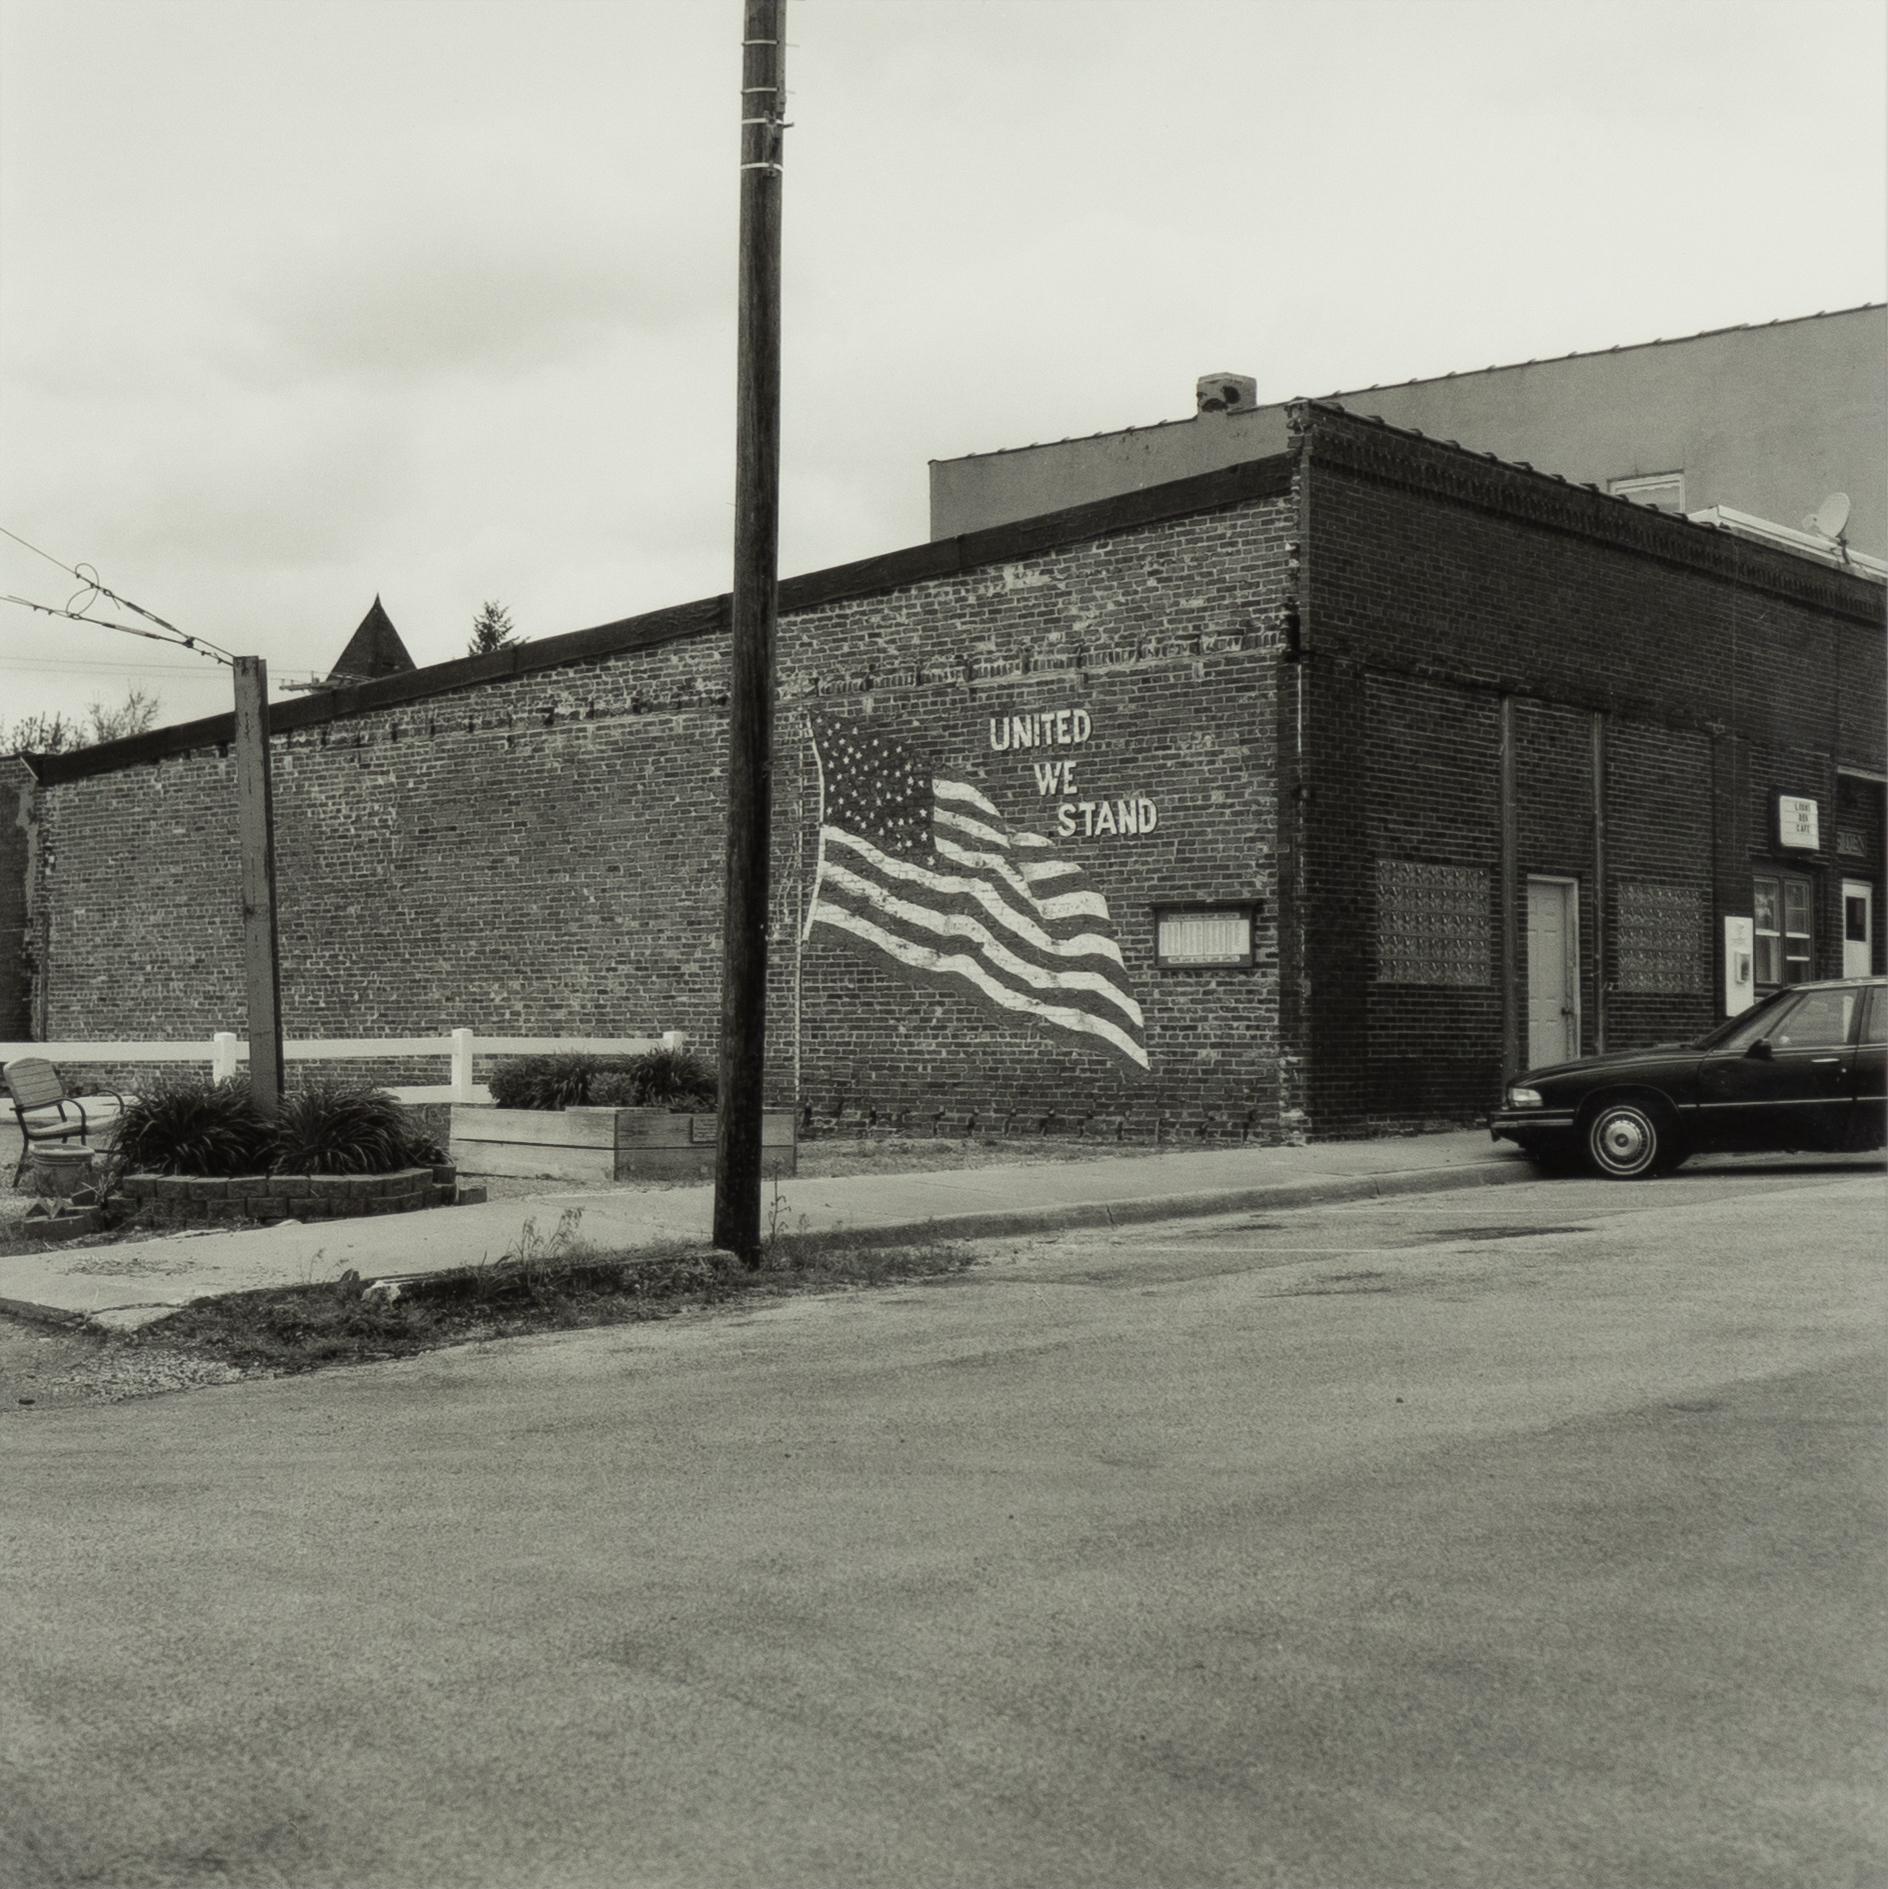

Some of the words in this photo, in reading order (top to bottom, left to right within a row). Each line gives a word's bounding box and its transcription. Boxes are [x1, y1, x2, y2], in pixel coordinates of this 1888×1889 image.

[990, 708, 1092, 751] UNITED
[1034, 760, 1078, 796] WE
[1058, 798, 1157, 837] STAND
